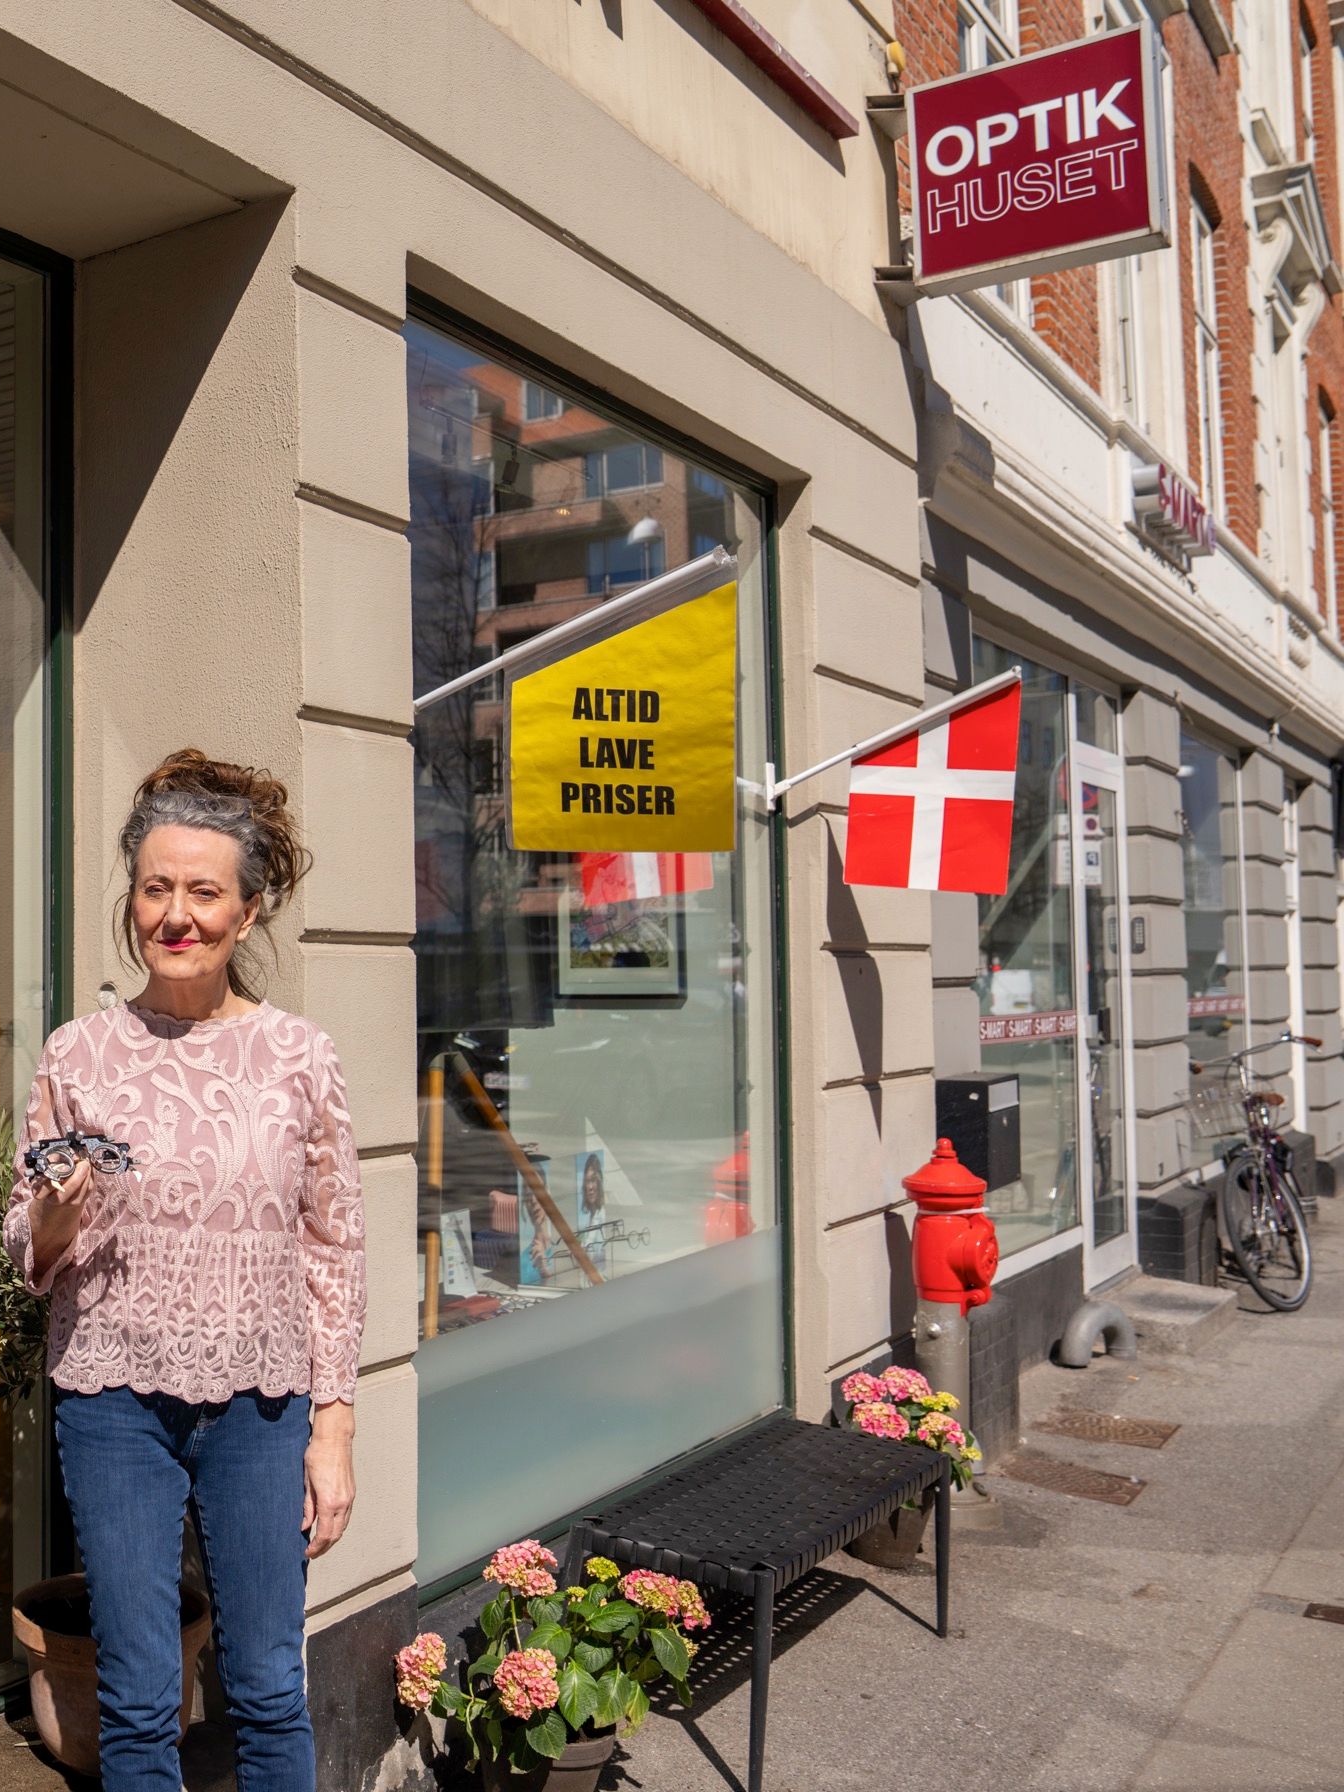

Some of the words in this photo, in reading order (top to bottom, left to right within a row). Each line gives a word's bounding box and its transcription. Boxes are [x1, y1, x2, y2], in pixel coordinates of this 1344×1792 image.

[925, 78, 1136, 176] OPTIK
[927, 138, 1138, 234] HUSET
[572, 687, 660, 723] ALTID
[579, 737, 655, 770] LAVE
[561, 782, 675, 815] PRISER
[980, 1021, 1006, 1039] S-MART
